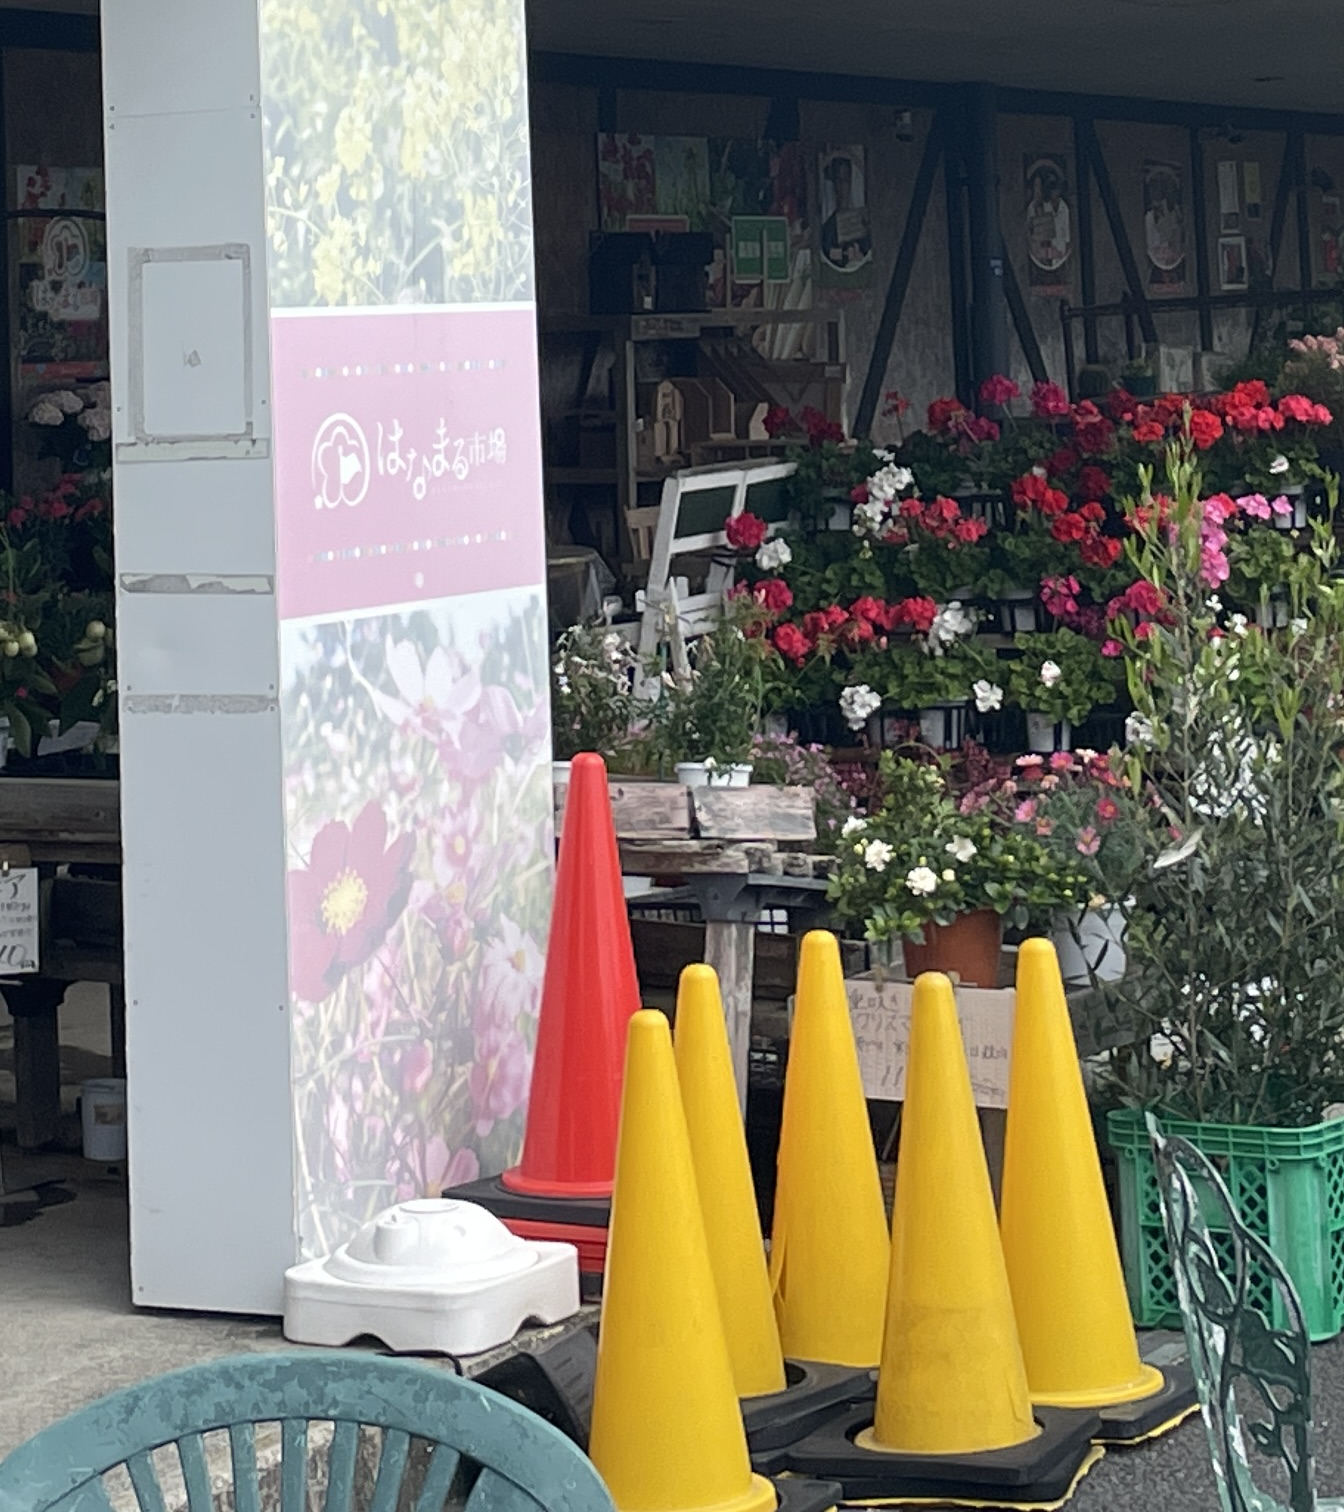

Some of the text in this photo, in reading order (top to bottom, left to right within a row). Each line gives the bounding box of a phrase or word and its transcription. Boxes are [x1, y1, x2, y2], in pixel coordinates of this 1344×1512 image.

[376, 417, 506, 500] はなまる市場
